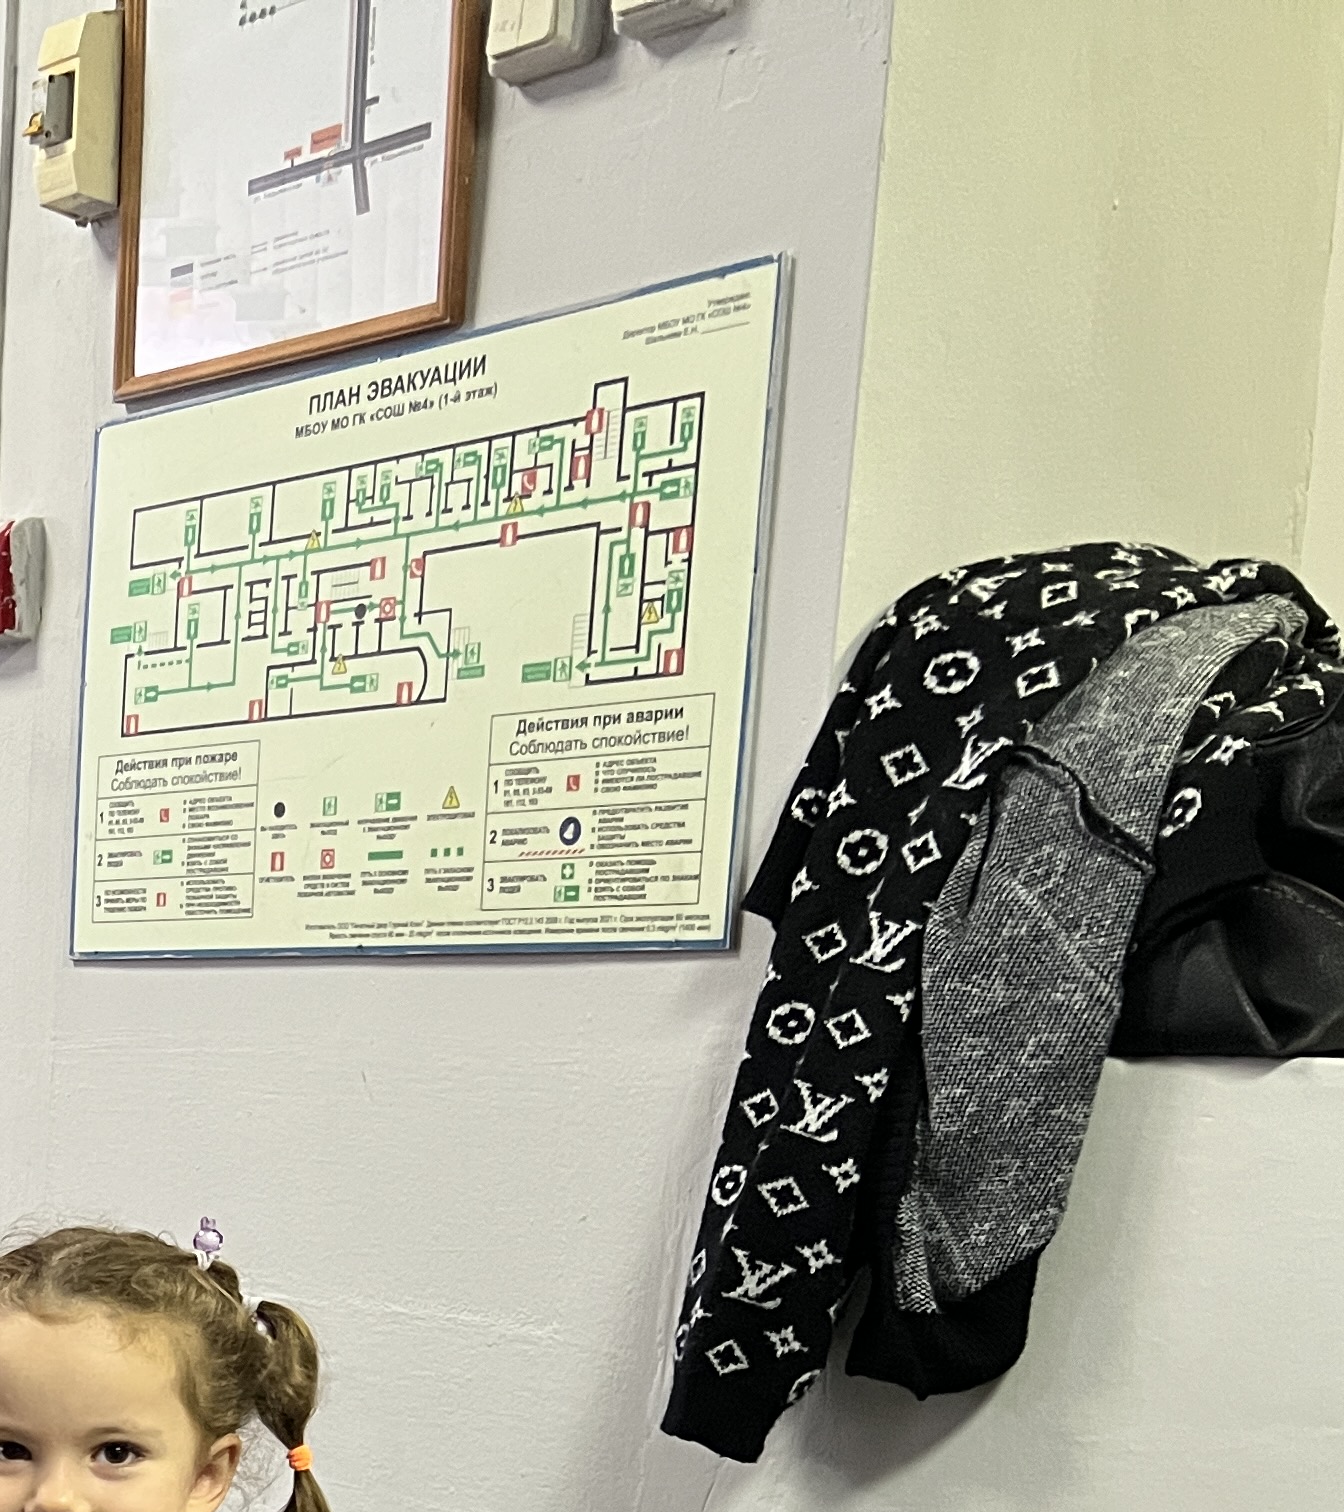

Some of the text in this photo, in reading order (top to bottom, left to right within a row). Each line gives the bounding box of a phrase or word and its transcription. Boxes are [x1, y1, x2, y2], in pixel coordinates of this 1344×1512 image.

[308, 354, 487, 415] ПЛАН ЭВАКУАЦИИ
[295, 420, 328, 439] МБОУ
[331, 416, 349, 431] МО
[352, 412, 366, 426] ГК
[370, 404, 405, 423] «СОШ
[464, 382, 498, 401] этаж)
[515, 706, 684, 737] Действия при аварии
[509, 725, 690, 756] Соблюдать спокойствие!
[115, 752, 238, 775] Действия при пожаре
[111, 767, 242, 792] Соблюдать спокойствие!
[493, 779, 499, 794] 1
[99, 811, 104, 824] 1
[489, 829, 498, 844] 2
[97, 853, 103, 866] 2
[486, 878, 494, 892] 3
[95, 895, 101, 907] 3
